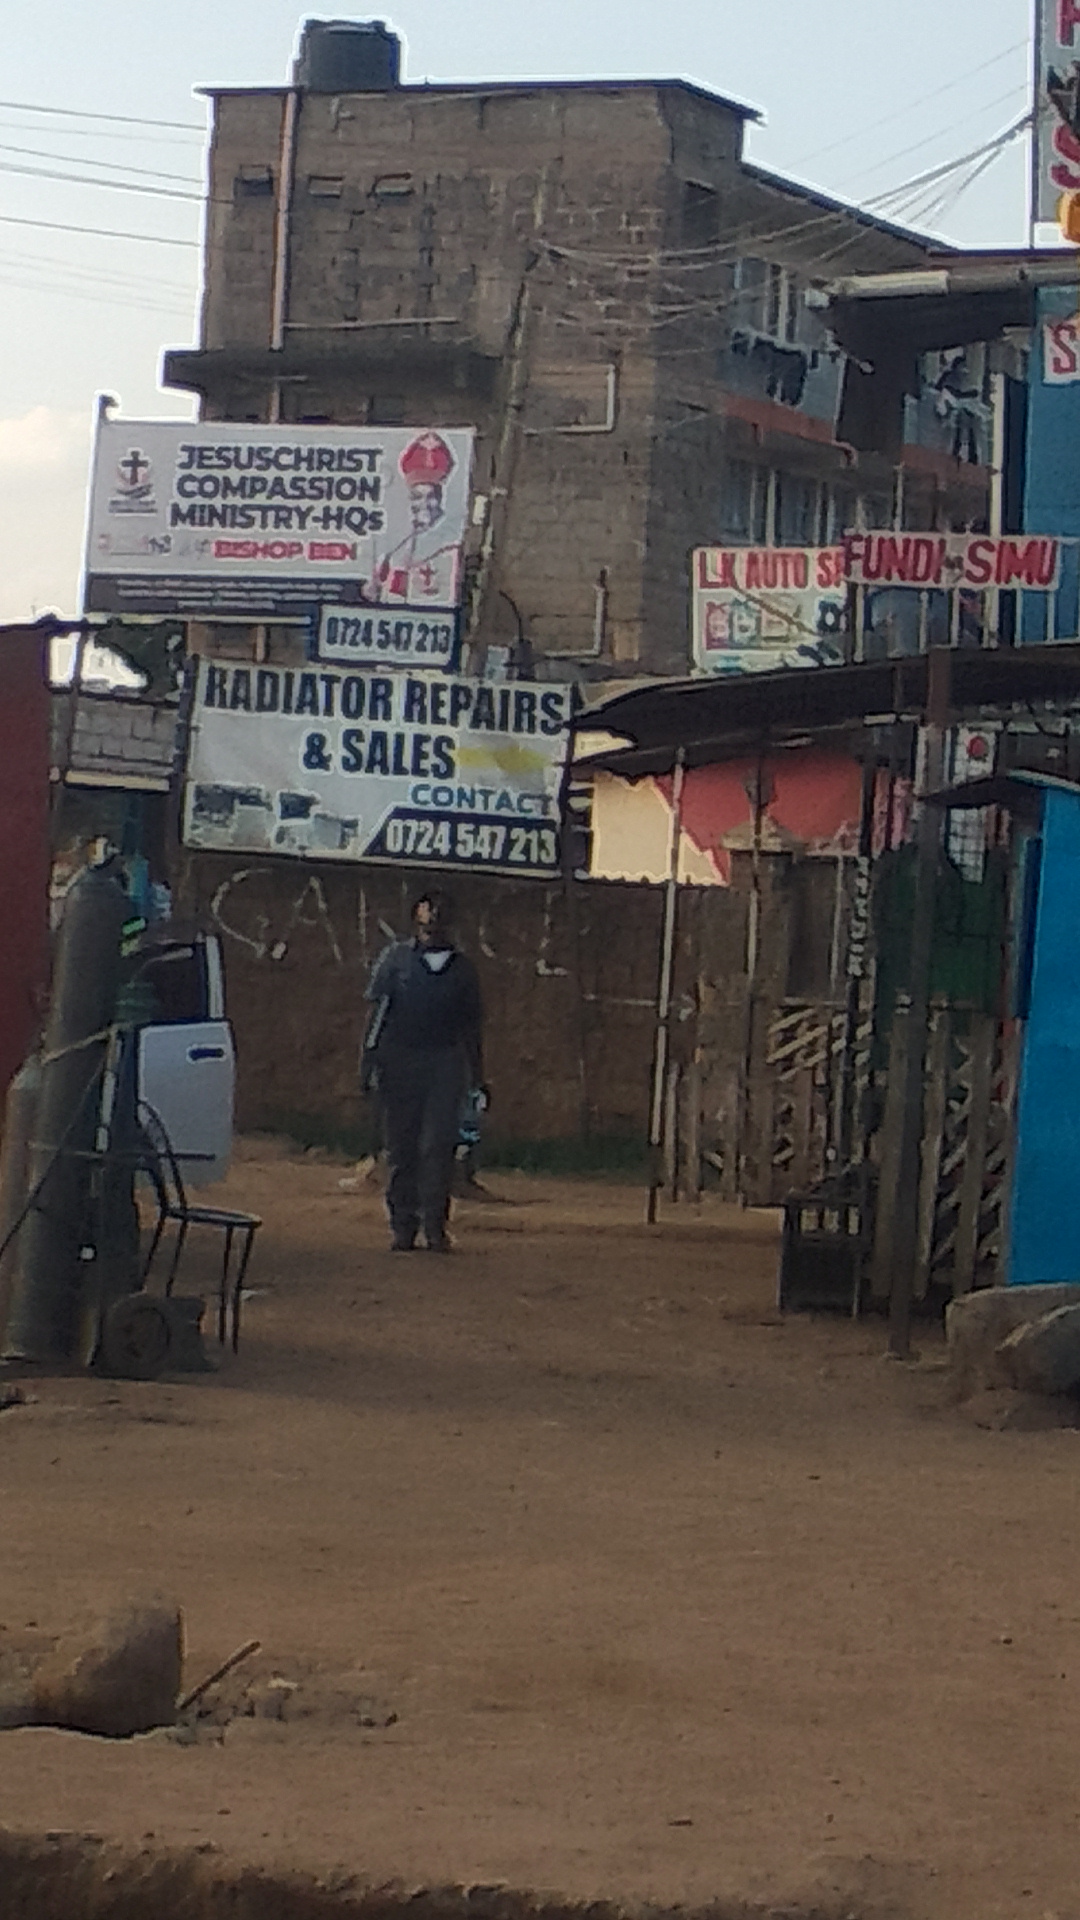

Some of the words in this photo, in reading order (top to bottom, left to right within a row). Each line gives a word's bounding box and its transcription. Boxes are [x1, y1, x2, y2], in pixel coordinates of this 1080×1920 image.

[178, 444, 384, 472] JESUSCHRIST
[177, 474, 381, 501] COMPASSION
[214, 538, 304, 560] BISHOP
[843, 534, 947, 584] FUNDI
[965, 539, 1060, 585] SIMU
[746, 551, 809, 589] AUTO
[204, 664, 394, 722] RADIATOR
[403, 677, 565, 736] REPAIRS
[303, 732, 333, 771] &
[341, 728, 456, 780] SALES
[411, 784, 553, 815] CONTACT
[386, 818, 452, 856] 0724
[455, 823, 506, 859] 547
[508, 827, 556, 863] 213
